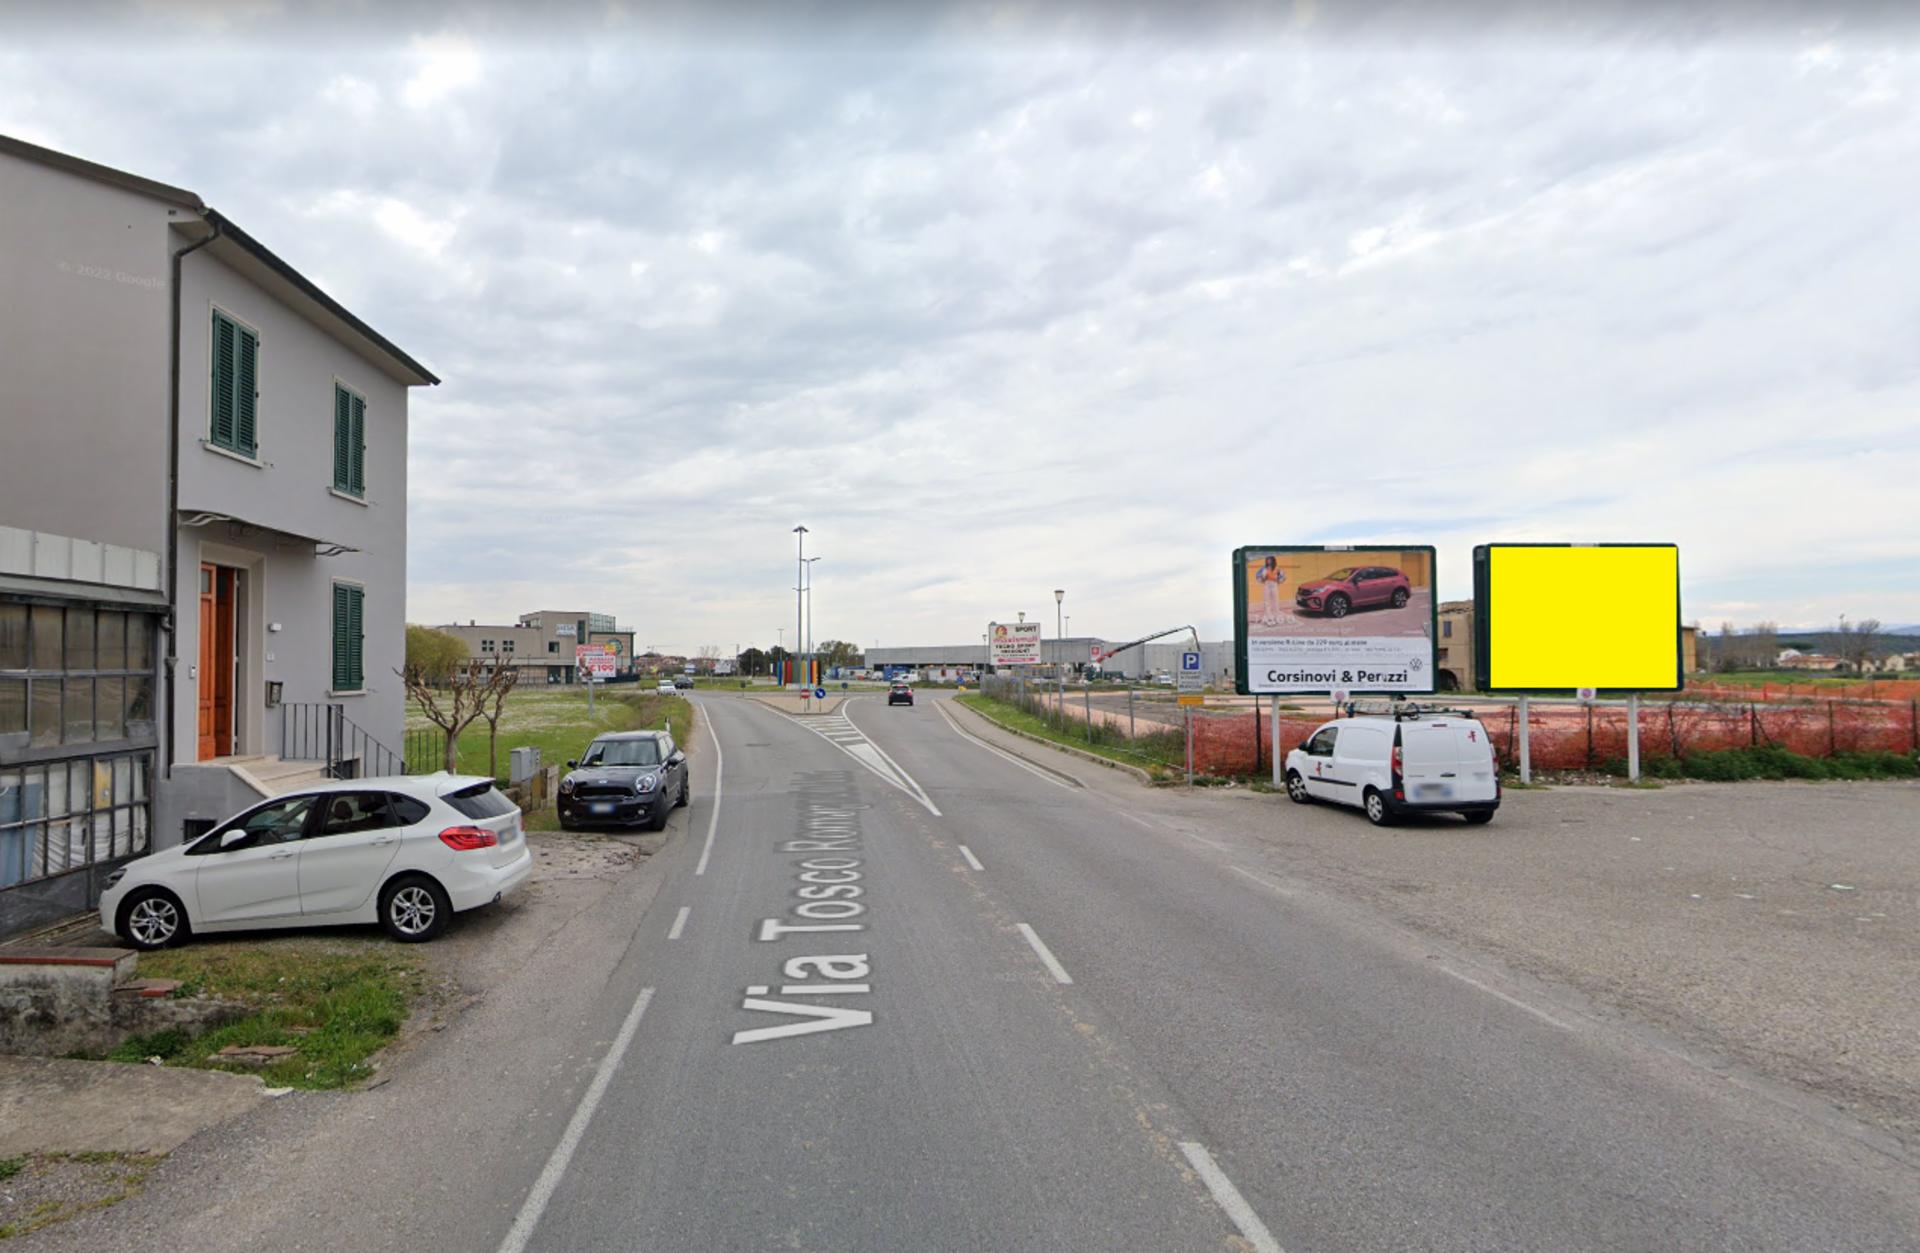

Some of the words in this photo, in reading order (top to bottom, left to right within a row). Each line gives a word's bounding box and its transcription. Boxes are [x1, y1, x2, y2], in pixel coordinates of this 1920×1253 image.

[1186, 654, 1197, 669] P
[1267, 669, 1336, 683] Corsinovi
[1341, 670, 1353, 683] &
